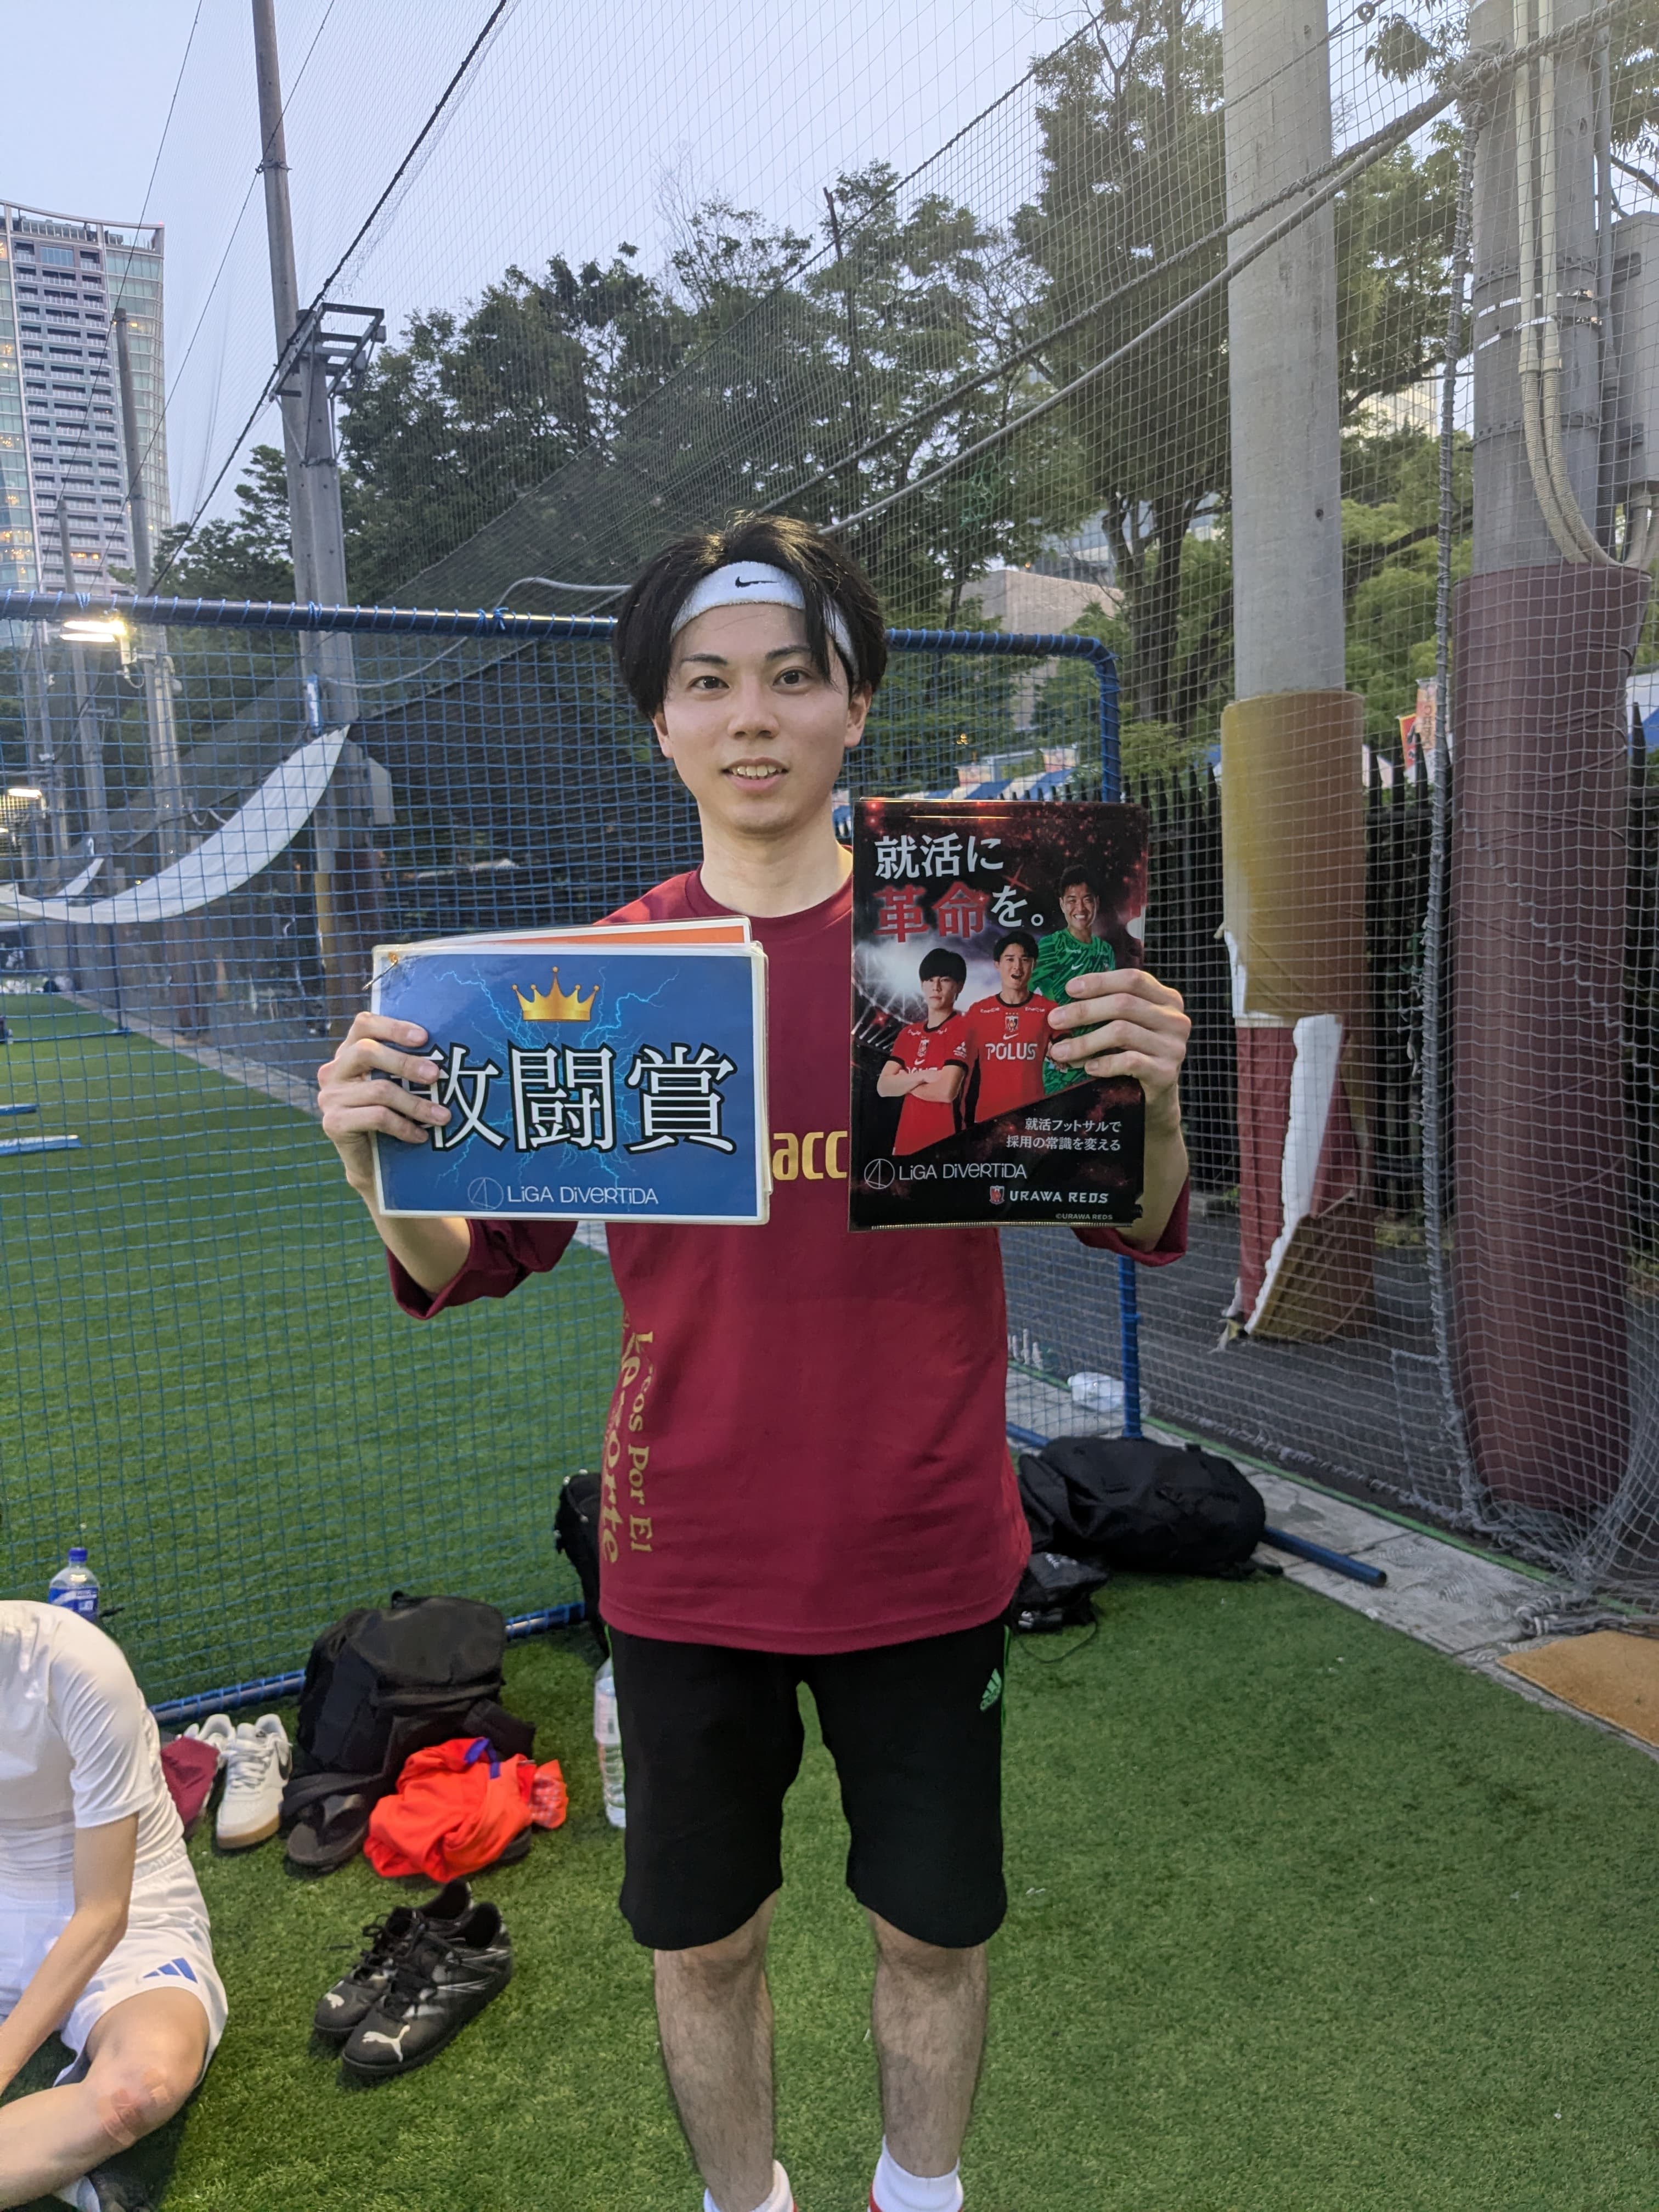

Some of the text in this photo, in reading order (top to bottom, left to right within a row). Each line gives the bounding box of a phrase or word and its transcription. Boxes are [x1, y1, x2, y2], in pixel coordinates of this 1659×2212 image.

[874, 832, 1004, 879] 就活に
[873, 882, 1045, 943] 革命を。
[984, 1042, 1039, 1061] POLUS
[1024, 1117, 1122, 1133] 就活フットサルで
[1006, 1134, 1121, 1152] 採用の常識を変える
[1009, 1190, 1109, 1204] URAWA REDS
[628, 1444, 650, 1505] Por
[629, 1515, 653, 1553] El
